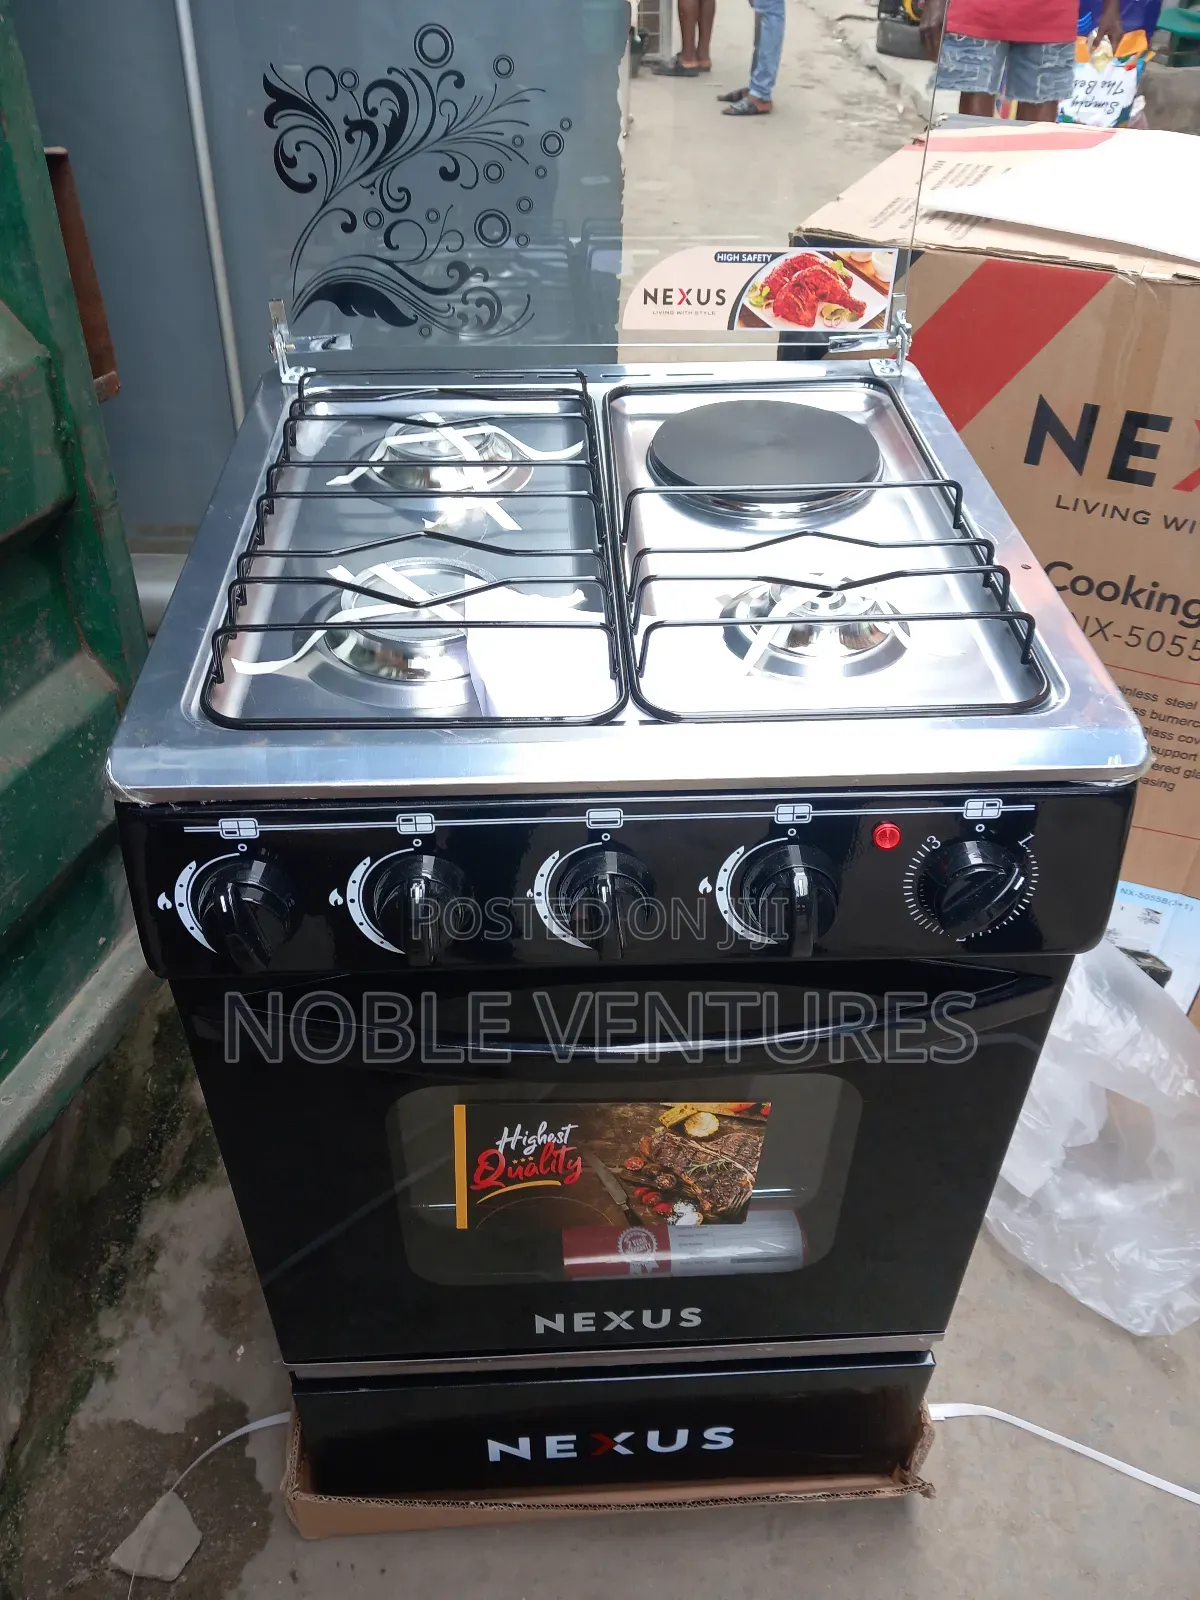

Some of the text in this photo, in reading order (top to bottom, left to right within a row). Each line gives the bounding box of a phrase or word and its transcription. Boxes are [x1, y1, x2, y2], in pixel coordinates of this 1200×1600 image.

[1100, 80, 1124, 96] The
[1071, 95, 1120, 115] Simply
[717, 252, 773, 263] HIGH SAFETY
[643, 287, 727, 306] NEXUS
[1055, 494, 1200, 535] LIVING WI
[1044, 561, 1200, 629] Cooking
[1165, 696, 1198, 711] steel
[1151, 745, 1198, 762] support
[926, 835, 941, 850] 3
[495, 1120, 579, 1156] Highest
[470, 1141, 582, 1191] Quality
[534, 1307, 703, 1334] NEXUS
[487, 1426, 735, 1462] NEXUS
